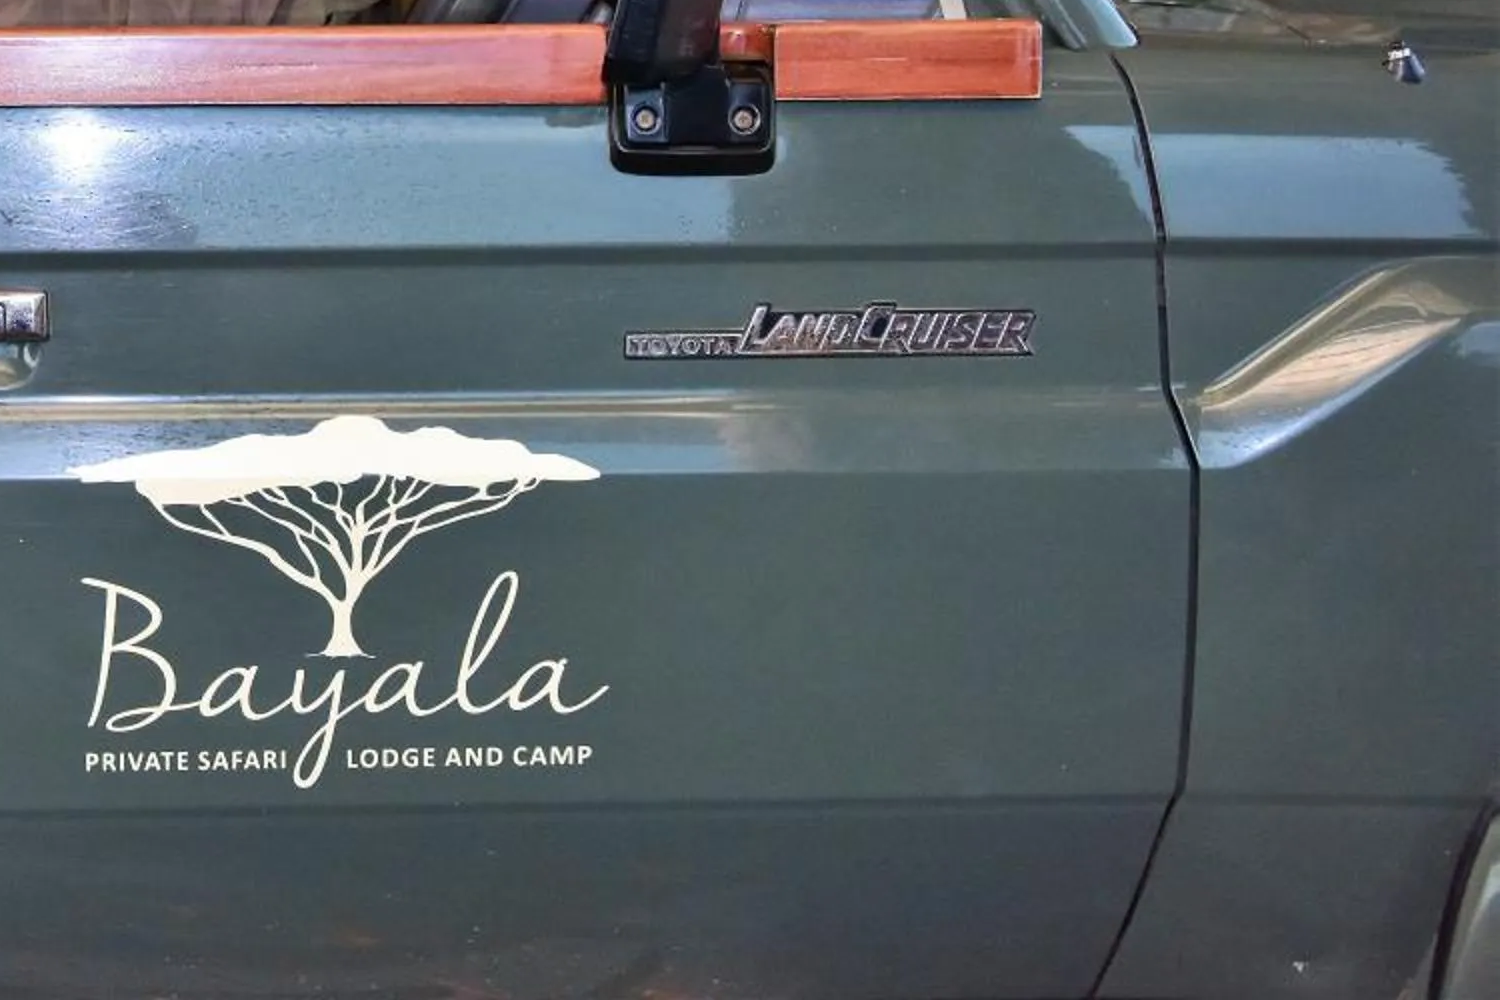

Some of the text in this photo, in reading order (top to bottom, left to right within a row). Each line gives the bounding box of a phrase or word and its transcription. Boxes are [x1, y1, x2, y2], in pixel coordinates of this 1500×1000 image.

[629, 335, 737, 356] TOYOTA
[81, 571, 610, 789] Bayala
[85, 745, 593, 772] PRIVATE SAFARI LODGE AND CAMP
